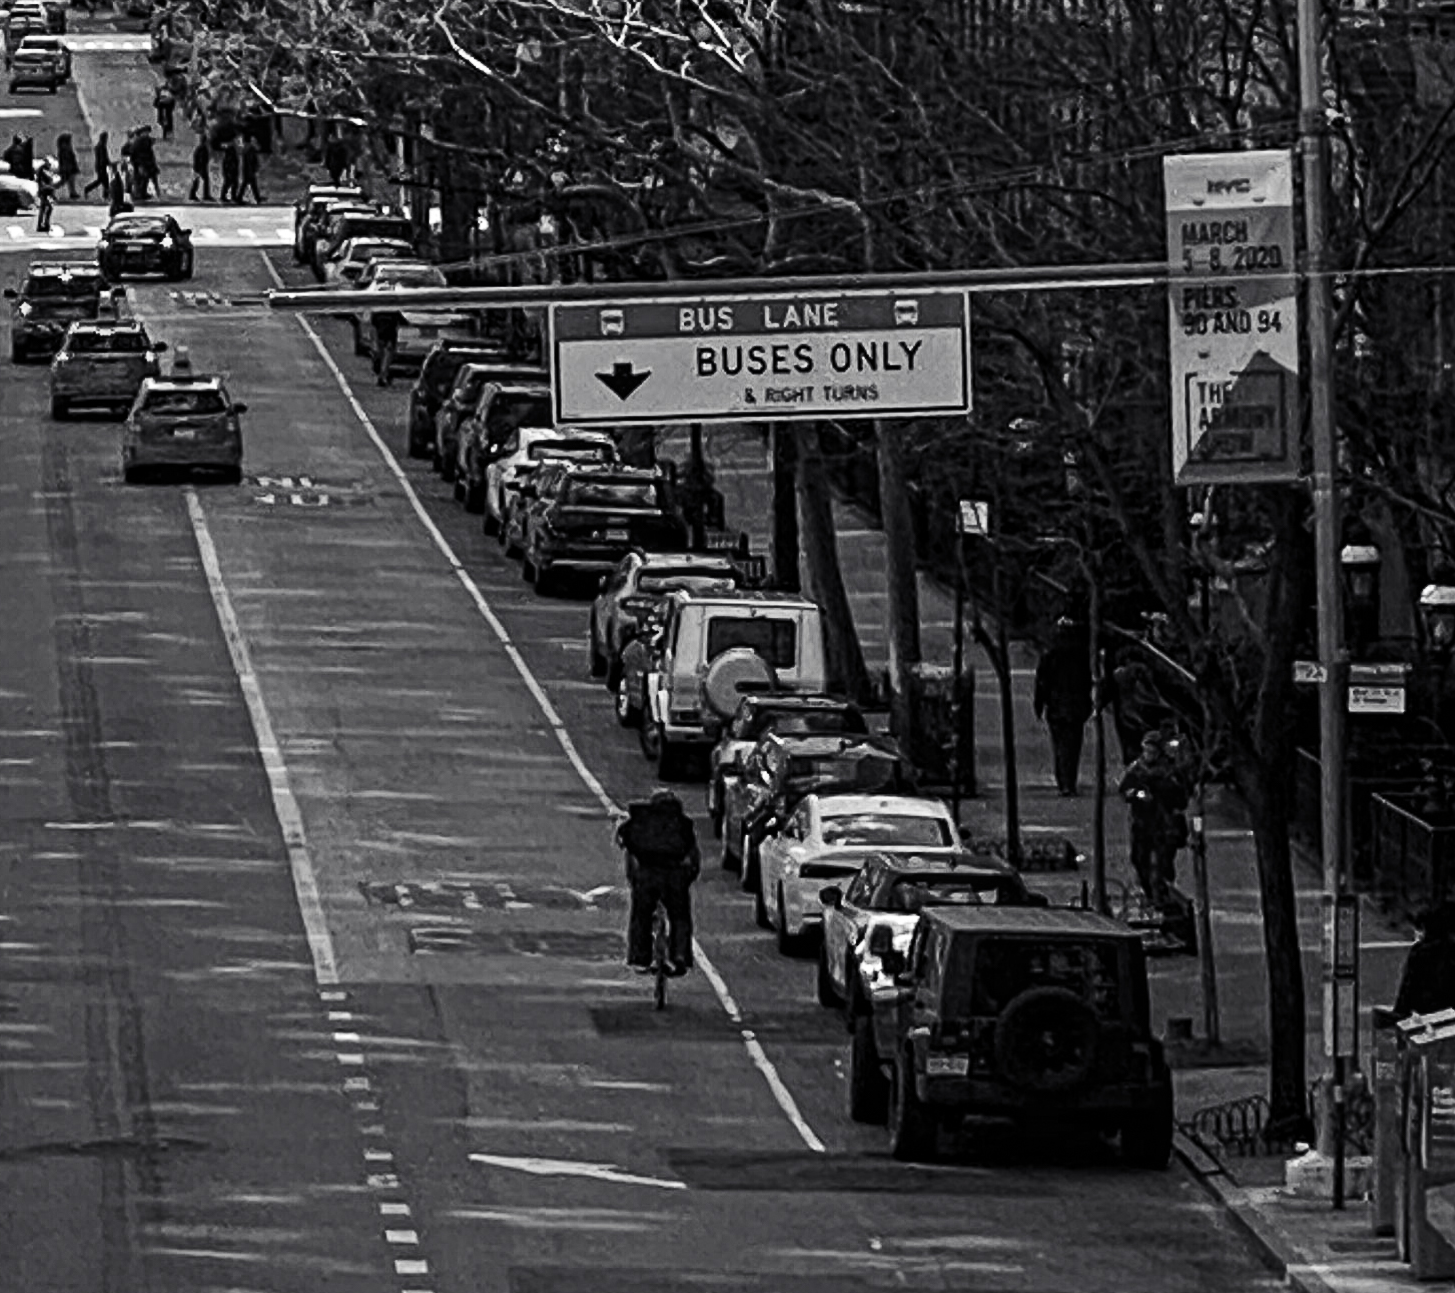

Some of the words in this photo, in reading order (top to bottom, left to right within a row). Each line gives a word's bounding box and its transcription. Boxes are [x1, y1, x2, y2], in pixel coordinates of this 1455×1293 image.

[1181, 220, 1248, 246] MARCH
[1232, 244, 1283, 270] 2020
[679, 307, 734, 332] BUS
[764, 303, 840, 329] LANE
[1184, 311, 1208, 336] 90
[1212, 308, 1252, 335] AND
[1257, 309, 1283, 334] 94
[696, 344, 814, 378] BUSES
[829, 339, 923, 373] ONLY
[744, 387, 756, 404] &
[764, 385, 815, 404] RIGHT
[823, 384, 880, 402] TURNS
[1196, 380, 1233, 405] THE
